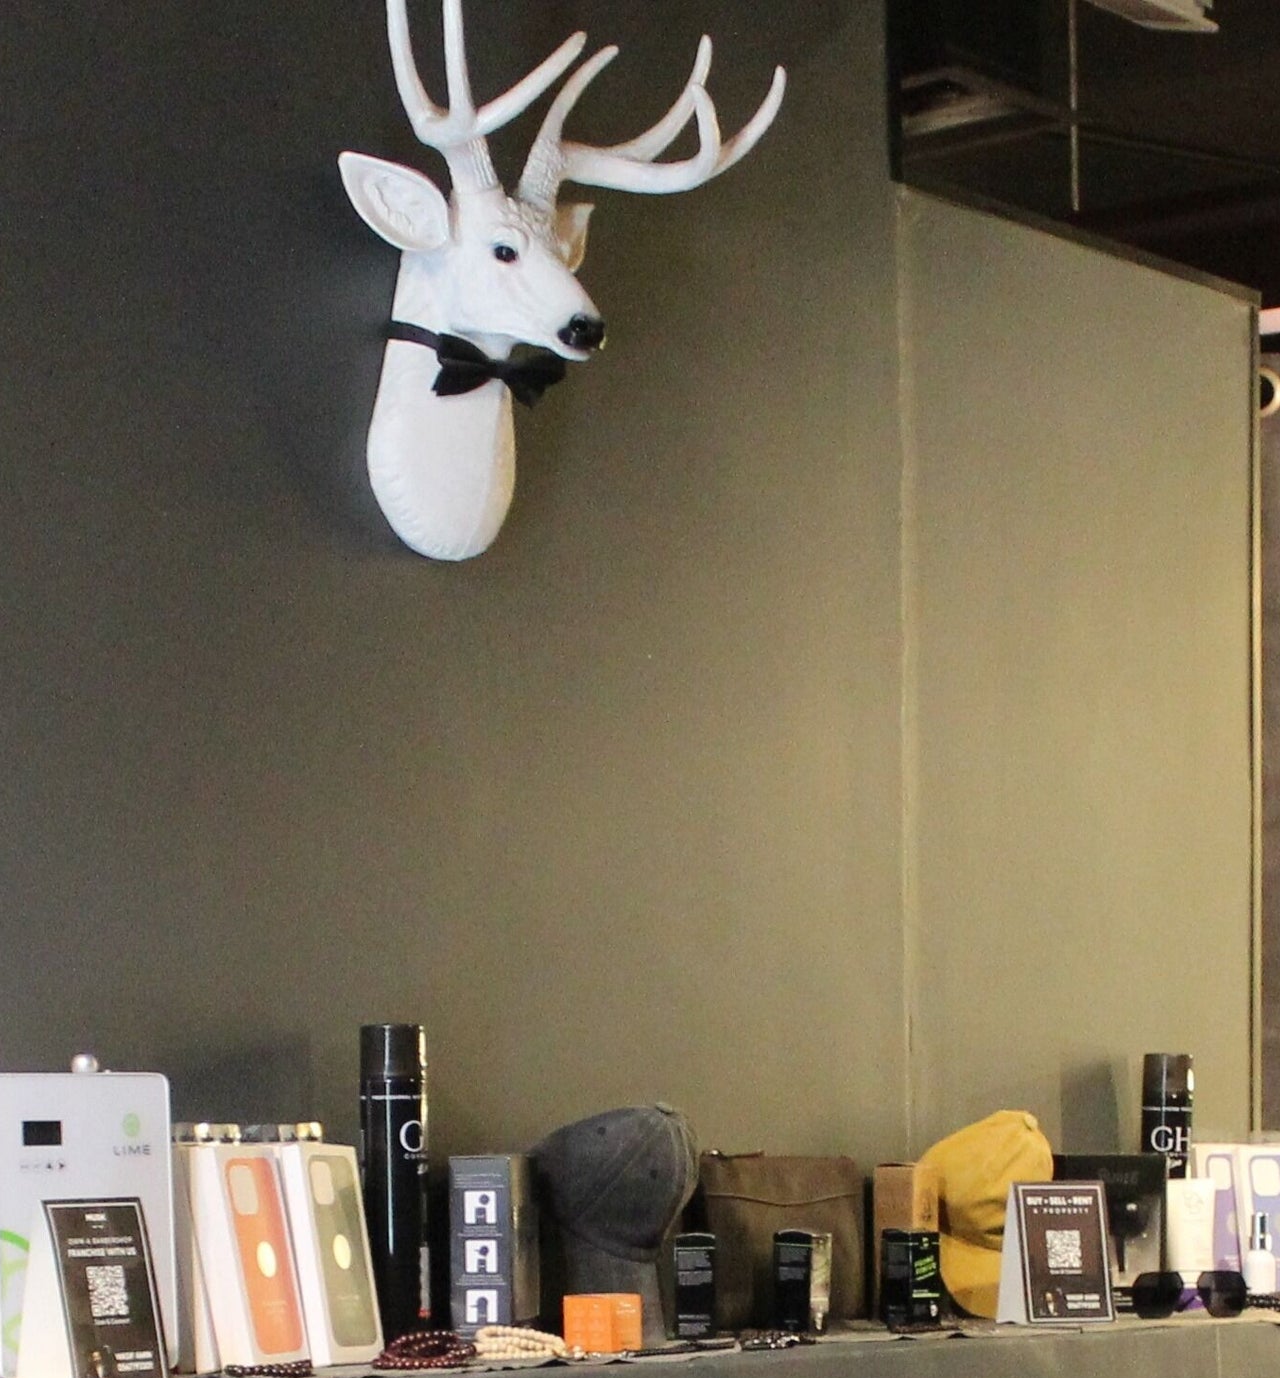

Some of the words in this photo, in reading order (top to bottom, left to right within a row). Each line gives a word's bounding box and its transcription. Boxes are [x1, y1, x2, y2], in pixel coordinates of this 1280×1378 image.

[112, 1144, 151, 1156] LIME
[1048, 1196, 1067, 1206] SELL
[1072, 1196, 1093, 1206] RENT
[1042, 1207, 1089, 1215] PROPERTY
[67, 1247, 106, 1258] FRANCHISE
